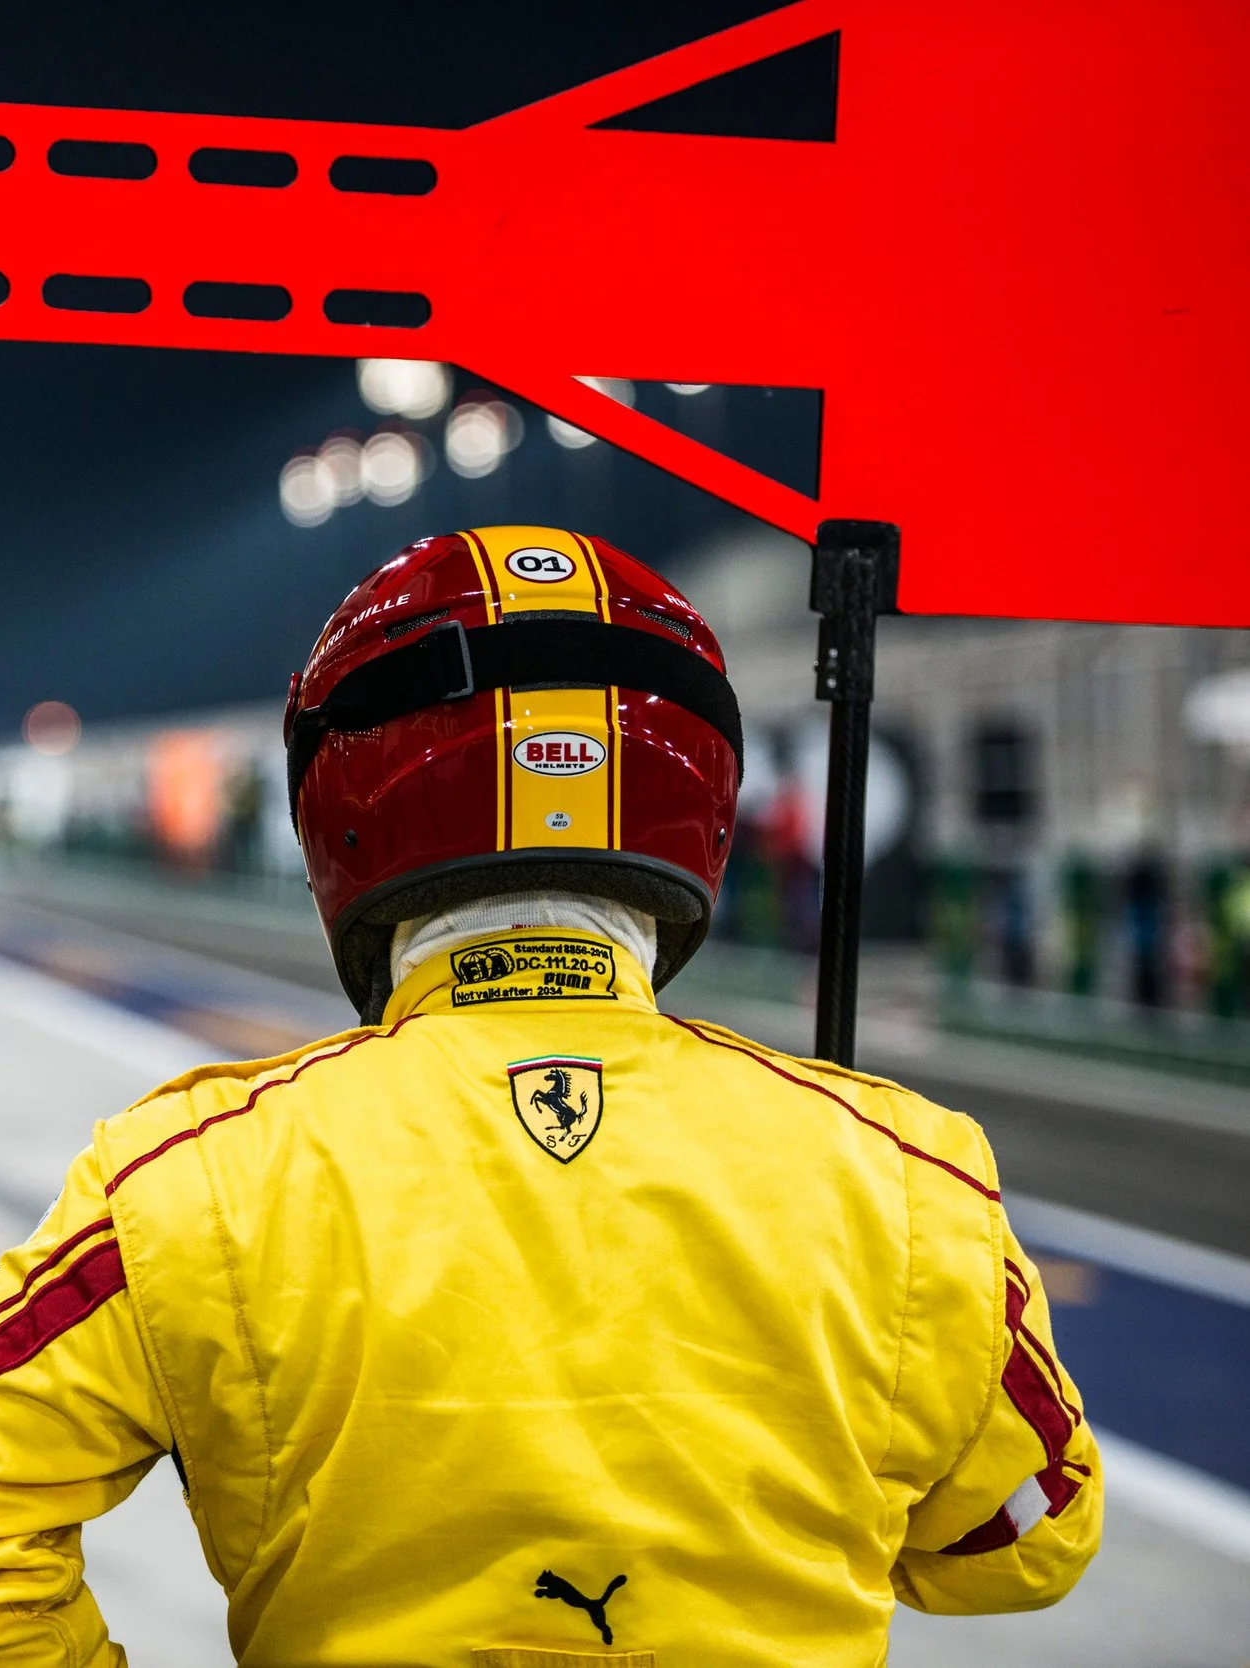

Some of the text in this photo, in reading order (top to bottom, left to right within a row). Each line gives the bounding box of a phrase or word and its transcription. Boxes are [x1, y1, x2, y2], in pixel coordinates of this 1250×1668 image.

[516, 556, 567, 573] 01
[350, 593, 411, 629] MILLE
[526, 742, 595, 762] BELL
[514, 943, 563, 954] Standard
[461, 956, 508, 984] FIA
[456, 985, 563, 1003] Not valid after: 2034
